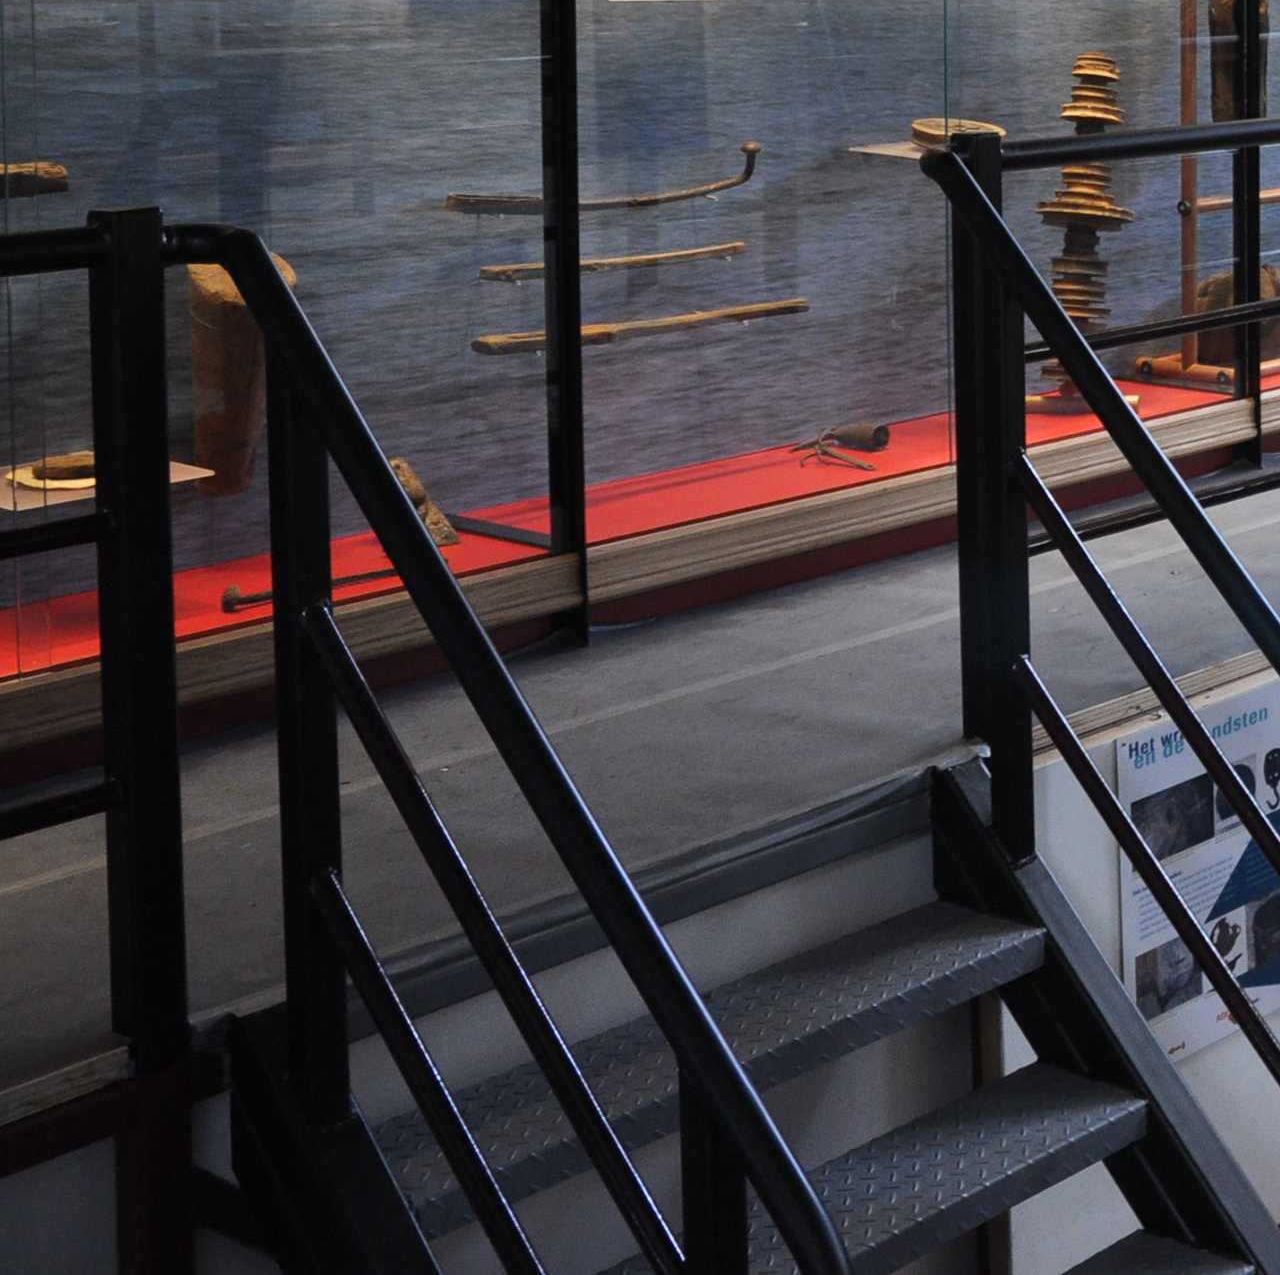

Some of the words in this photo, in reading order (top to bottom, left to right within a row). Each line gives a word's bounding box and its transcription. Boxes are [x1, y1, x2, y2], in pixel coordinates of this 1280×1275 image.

[1128, 737, 1155, 759] Het
[1134, 750, 1156, 770] en
[1162, 738, 1185, 759] de
[1211, 706, 1268, 741] ndsten
